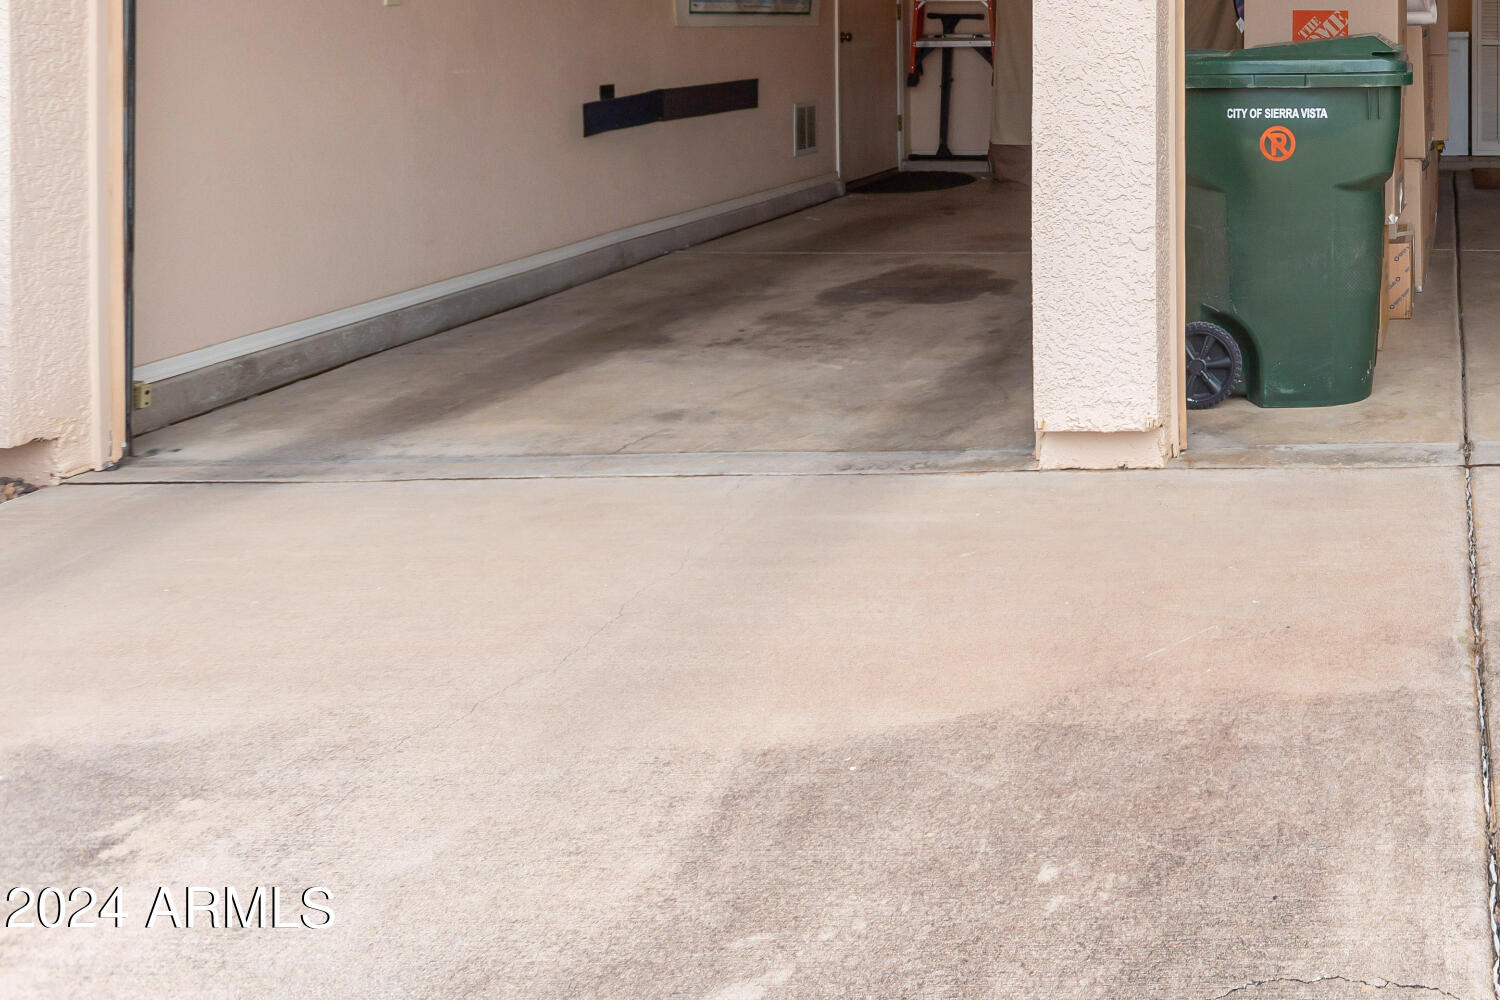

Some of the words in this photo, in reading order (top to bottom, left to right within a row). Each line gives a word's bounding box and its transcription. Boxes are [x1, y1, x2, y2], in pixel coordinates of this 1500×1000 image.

[1297, 15, 1322, 40] THE
[1226, 108, 1248, 119] CITY
[1249, 108, 1262, 119] OF
[1264, 108, 1299, 119] SIERRA
[1300, 108, 1328, 119] VISTA
